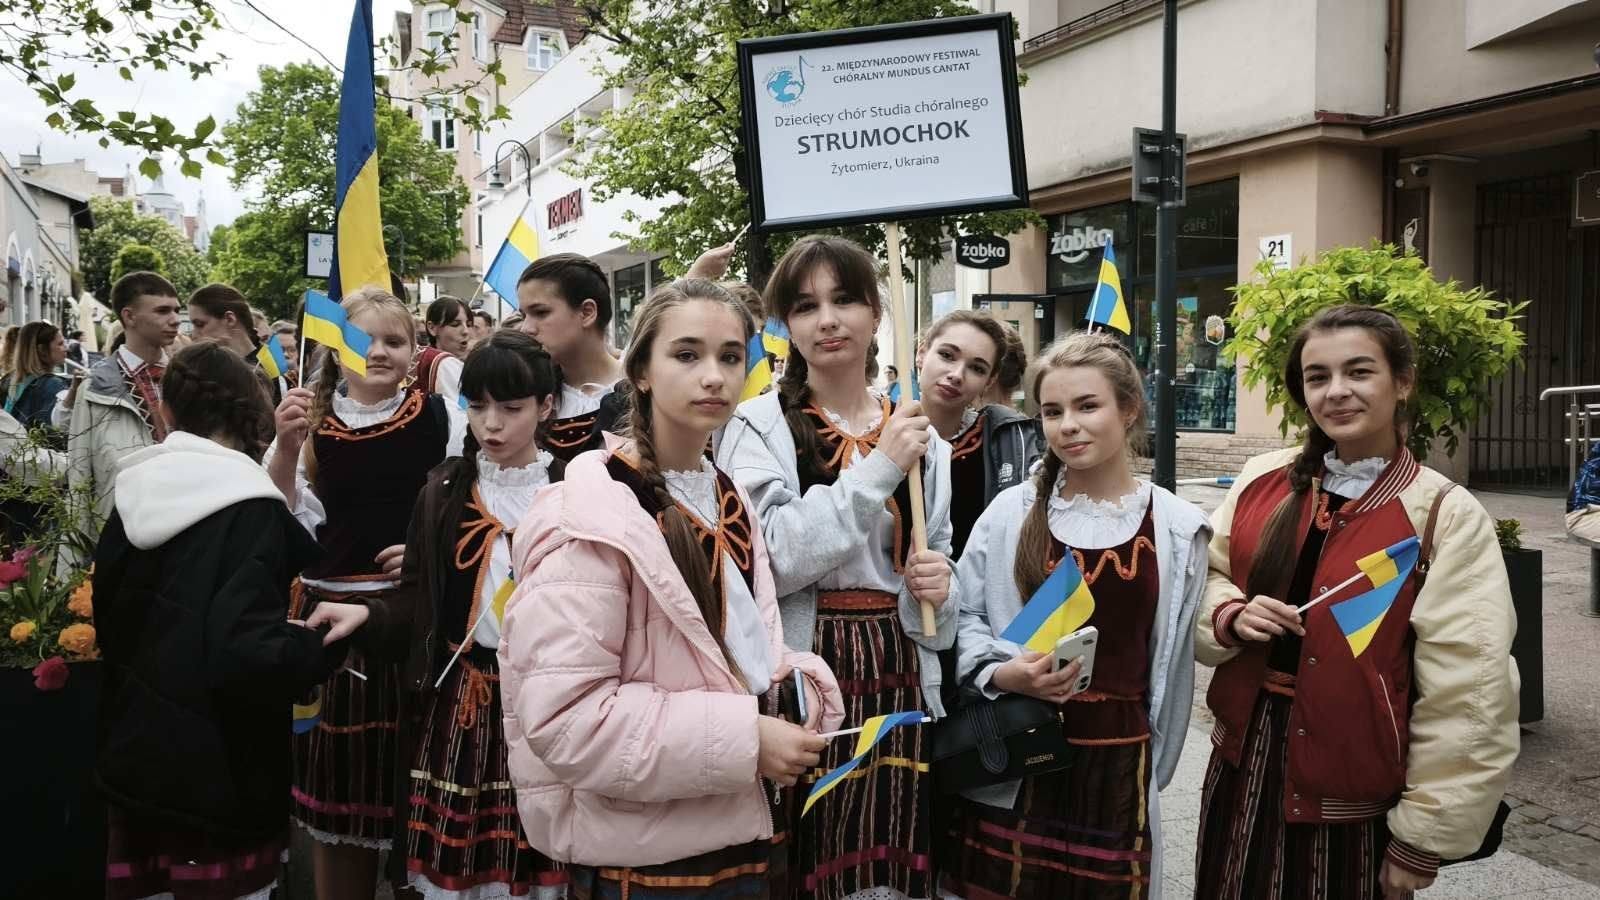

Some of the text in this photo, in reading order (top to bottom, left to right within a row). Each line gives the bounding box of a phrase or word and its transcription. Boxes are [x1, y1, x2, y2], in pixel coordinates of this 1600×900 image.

[836, 53, 931, 71] MIĘDZYNARODOWY
[933, 48, 981, 61] FESTIWAL
[833, 62, 971, 84] CHÓRALNY MUNDUS CANTAT
[775, 97, 989, 128] Dziecięcy chór Studia chóralnego
[797, 119, 970, 155] STRUMOCHOK
[831, 154, 940, 176] Żytomierz, Ukraina
[962, 242, 1005, 258] żabka
[1051, 226, 1114, 255] żabka
[1268, 239, 1284, 257] 21
